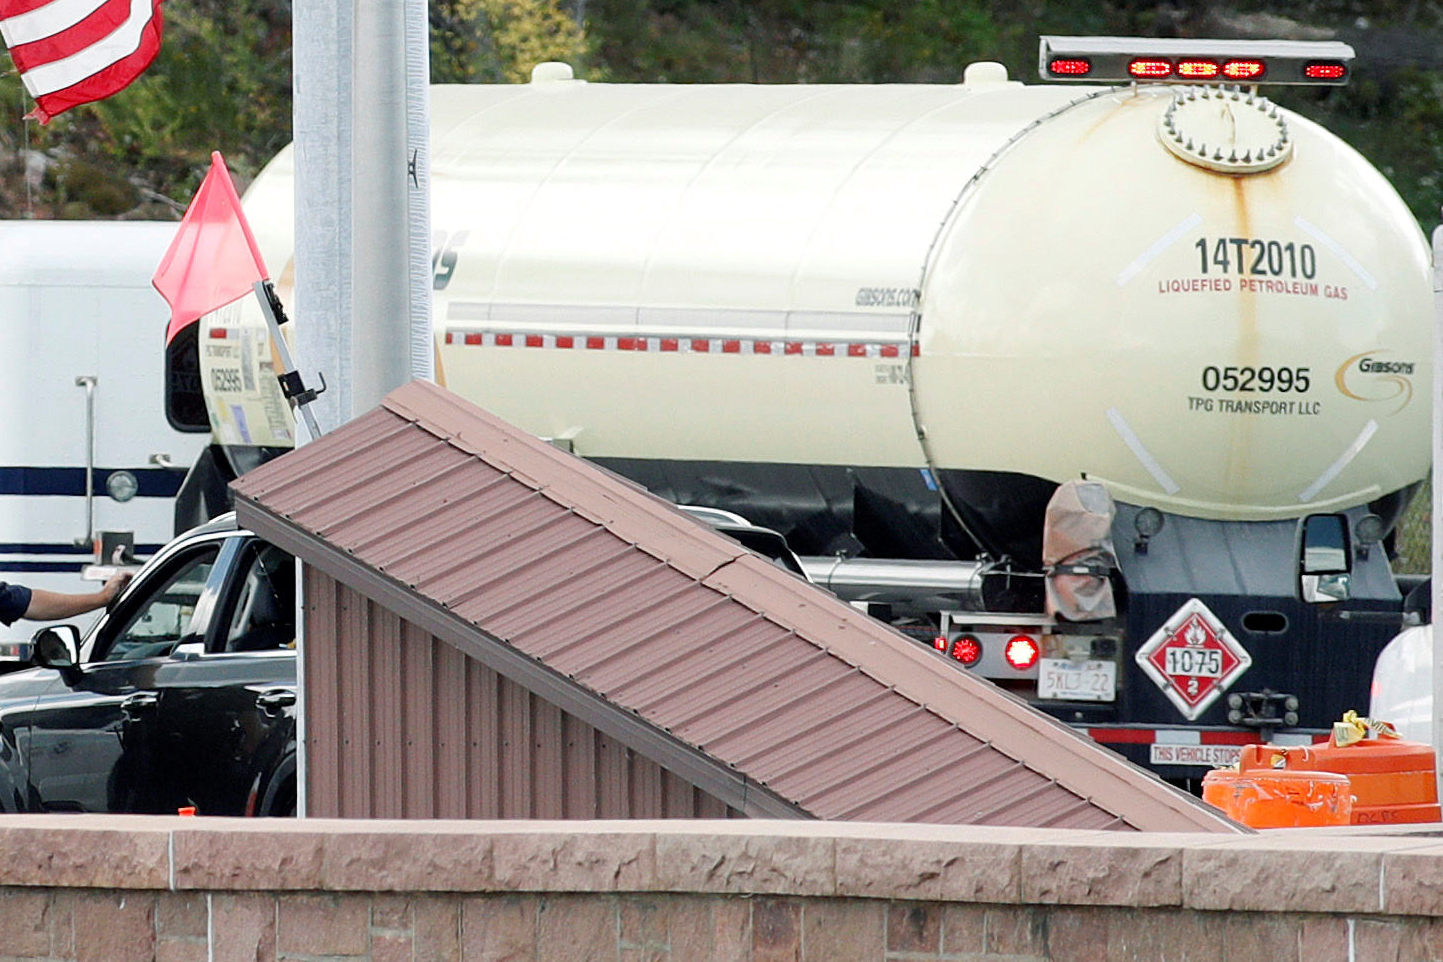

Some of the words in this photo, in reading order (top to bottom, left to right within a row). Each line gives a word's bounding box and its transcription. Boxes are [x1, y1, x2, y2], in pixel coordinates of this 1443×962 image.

[1196, 237, 1316, 280] 14T2010
[1159, 278, 1233, 294] LIQUEFIED
[1239, 278, 1320, 297] PETROLEUM
[1324, 285, 1349, 301] GAS
[1202, 366, 1310, 392] 052995
[1188, 397, 1214, 412] TPG
[1218, 399, 1296, 414] TRANSPORT
[1298, 403, 1321, 415] LLC
[1168, 650, 1220, 674] 1075
[1187, 679, 1199, 697] 2
[1154, 746, 1172, 760] THIS
[1175, 747, 1211, 762] VEHICLE
